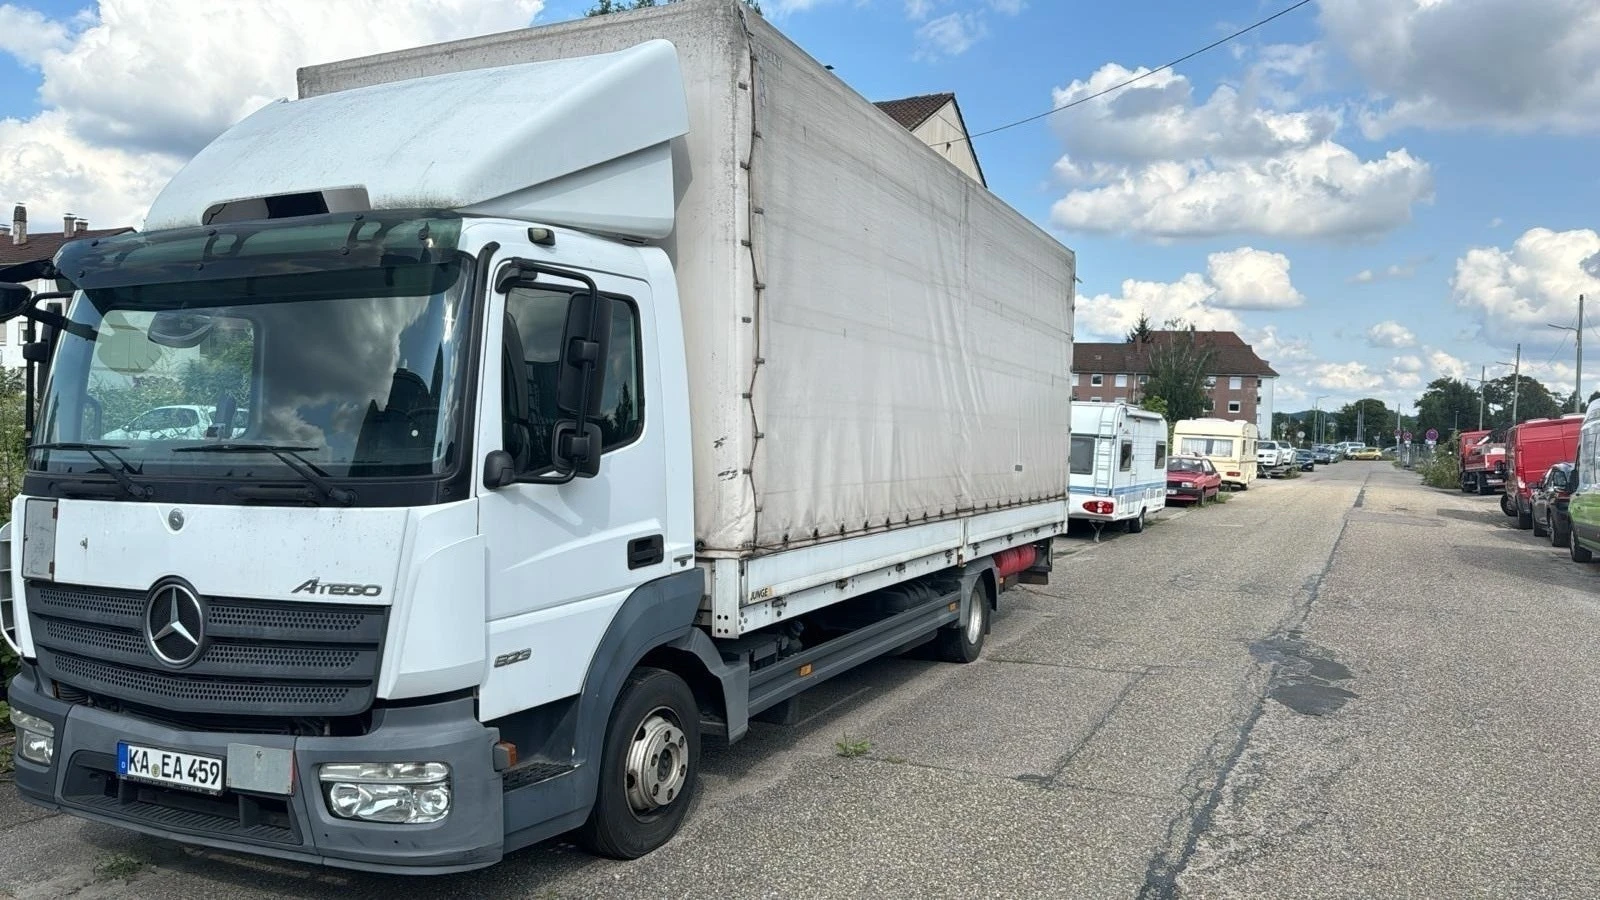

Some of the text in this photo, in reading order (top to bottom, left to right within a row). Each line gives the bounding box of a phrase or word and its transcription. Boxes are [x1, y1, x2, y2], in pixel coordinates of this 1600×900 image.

[750, 588, 768, 600] JUNGE
[494, 648, 531, 668] 823
[129, 749, 149, 773] KA
[161, 754, 183, 780] EA
[187, 758, 220, 785] 459
